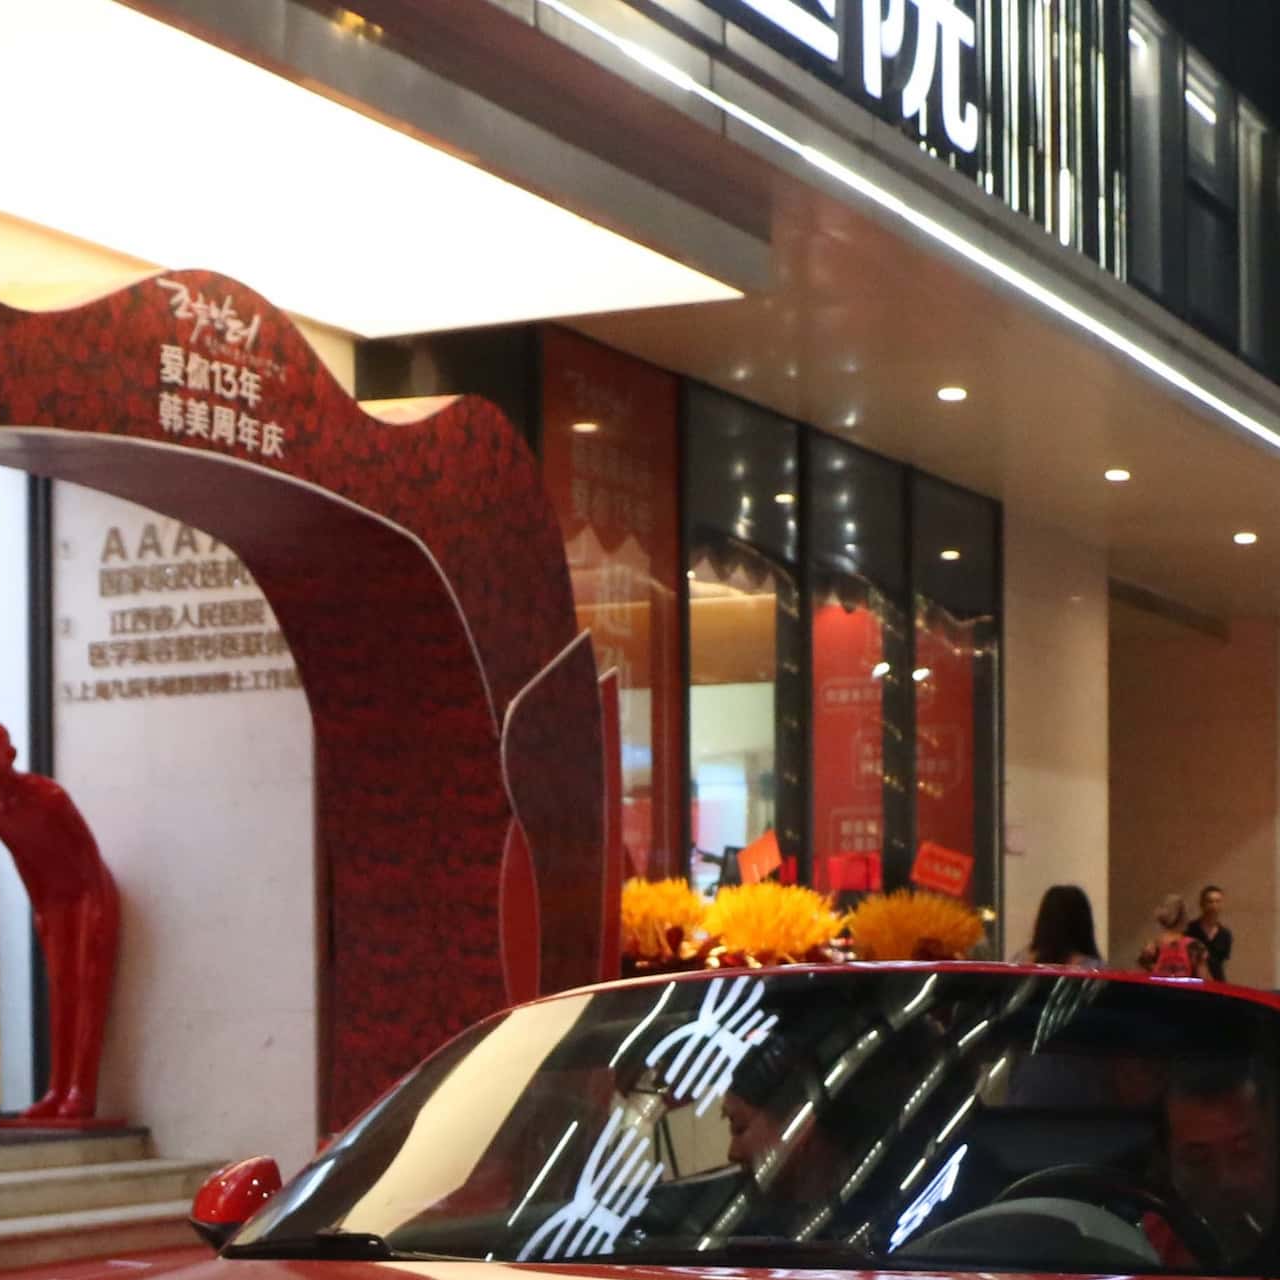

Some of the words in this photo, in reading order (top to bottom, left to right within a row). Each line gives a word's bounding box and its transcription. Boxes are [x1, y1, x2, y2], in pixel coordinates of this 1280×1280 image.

[158, 391, 285, 459] 韩美周年庆
